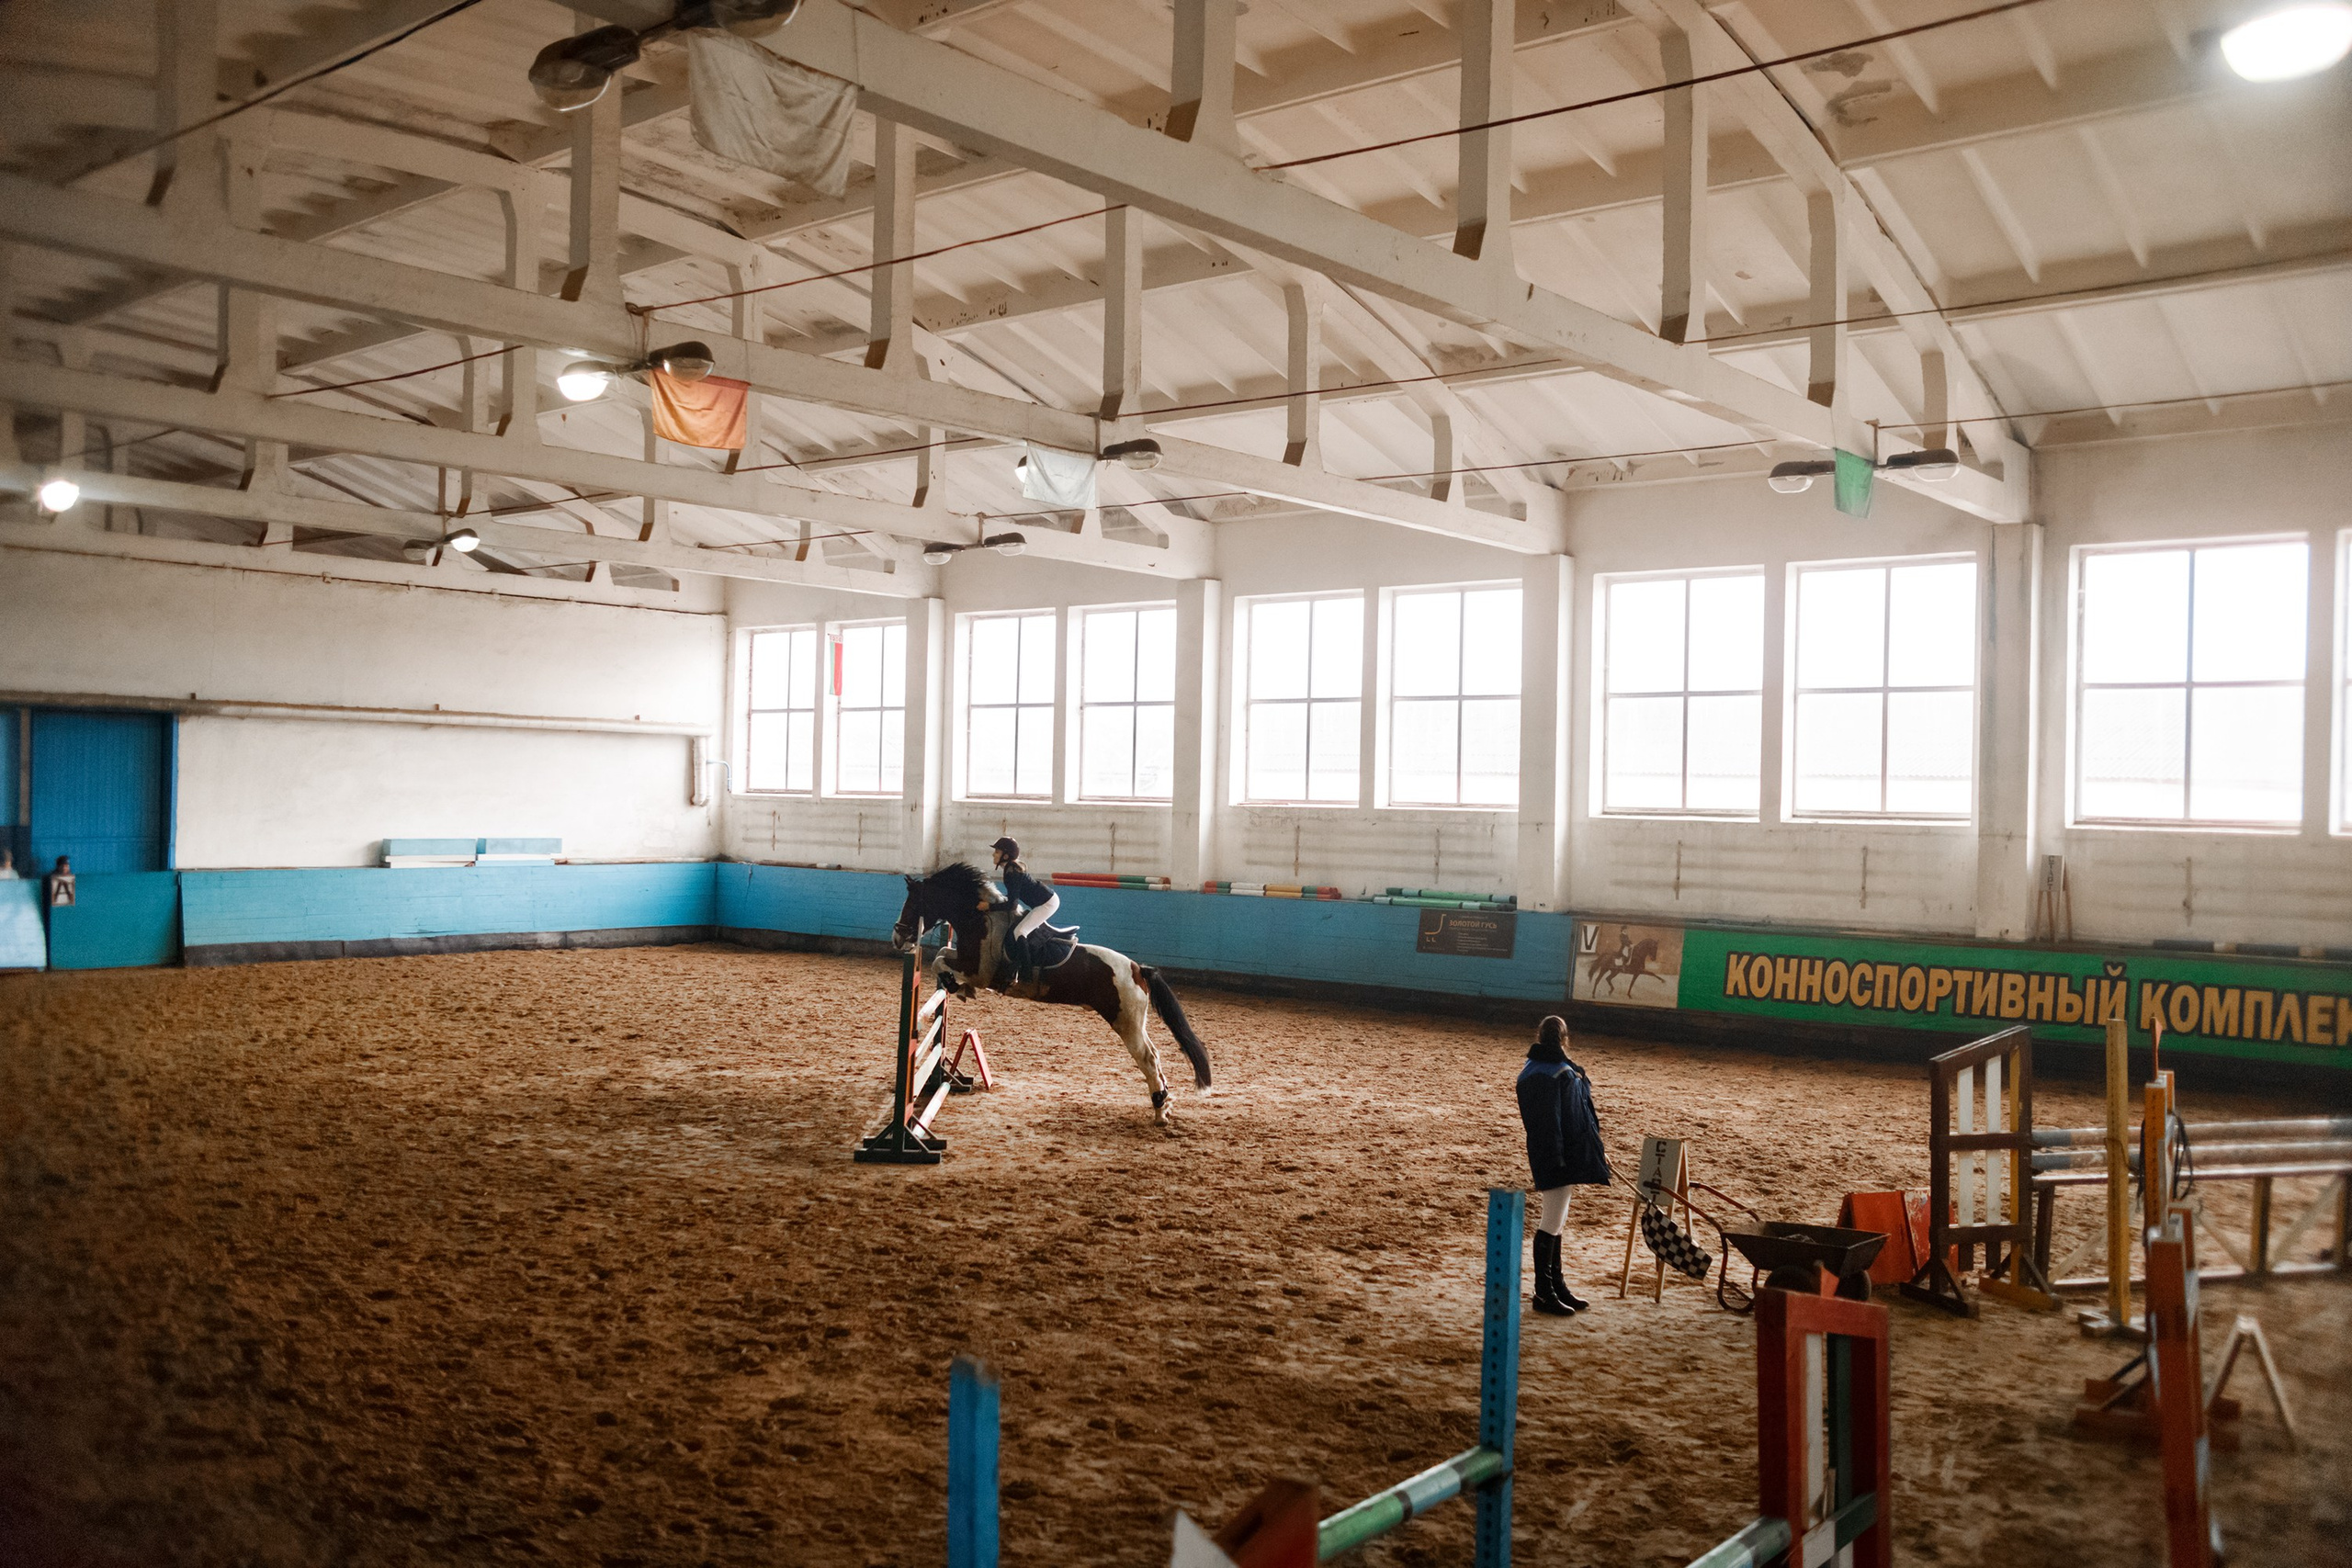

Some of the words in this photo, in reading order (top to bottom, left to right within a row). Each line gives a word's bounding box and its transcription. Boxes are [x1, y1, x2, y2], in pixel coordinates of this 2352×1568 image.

[53, 878, 74, 904] A
[1449, 919, 1480, 929] ЗОЛОТОЙ
[1481, 921, 1498, 930] ГУСЬ
[1583, 925, 1600, 950] V
[1724, 953, 2128, 1026] КОННОСПОРТИВНЫЙ
